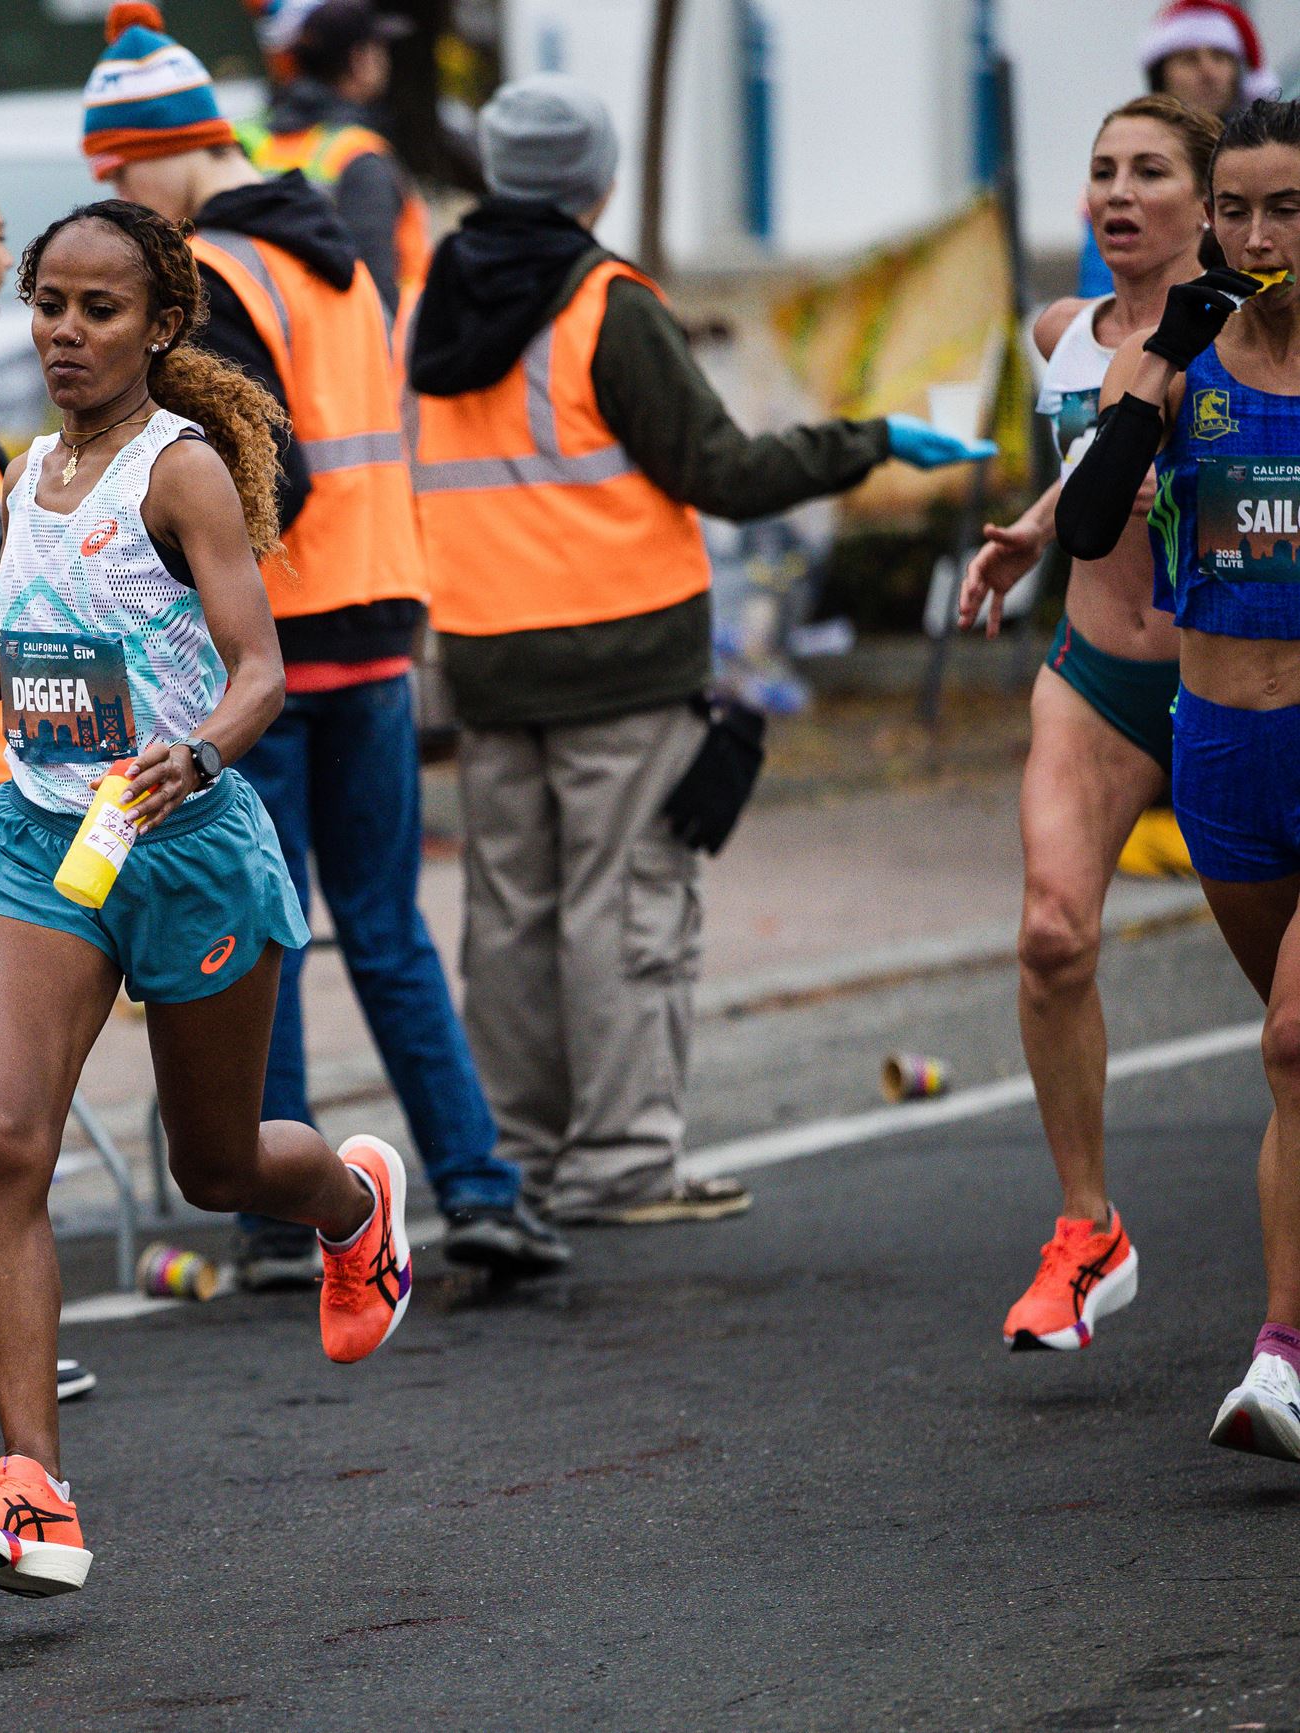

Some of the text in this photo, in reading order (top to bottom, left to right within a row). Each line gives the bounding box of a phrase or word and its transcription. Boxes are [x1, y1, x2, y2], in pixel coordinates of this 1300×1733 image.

[1237, 499, 1300, 533] SAIL
[1216, 550, 1242, 559] 2025
[1216, 559, 1244, 569] ELITE
[23, 641, 68, 653] CALIFORNIA
[74, 649, 96, 660] CIM
[12, 677, 94, 713] DEGEFA
[100, 740, 108, 749] 4
